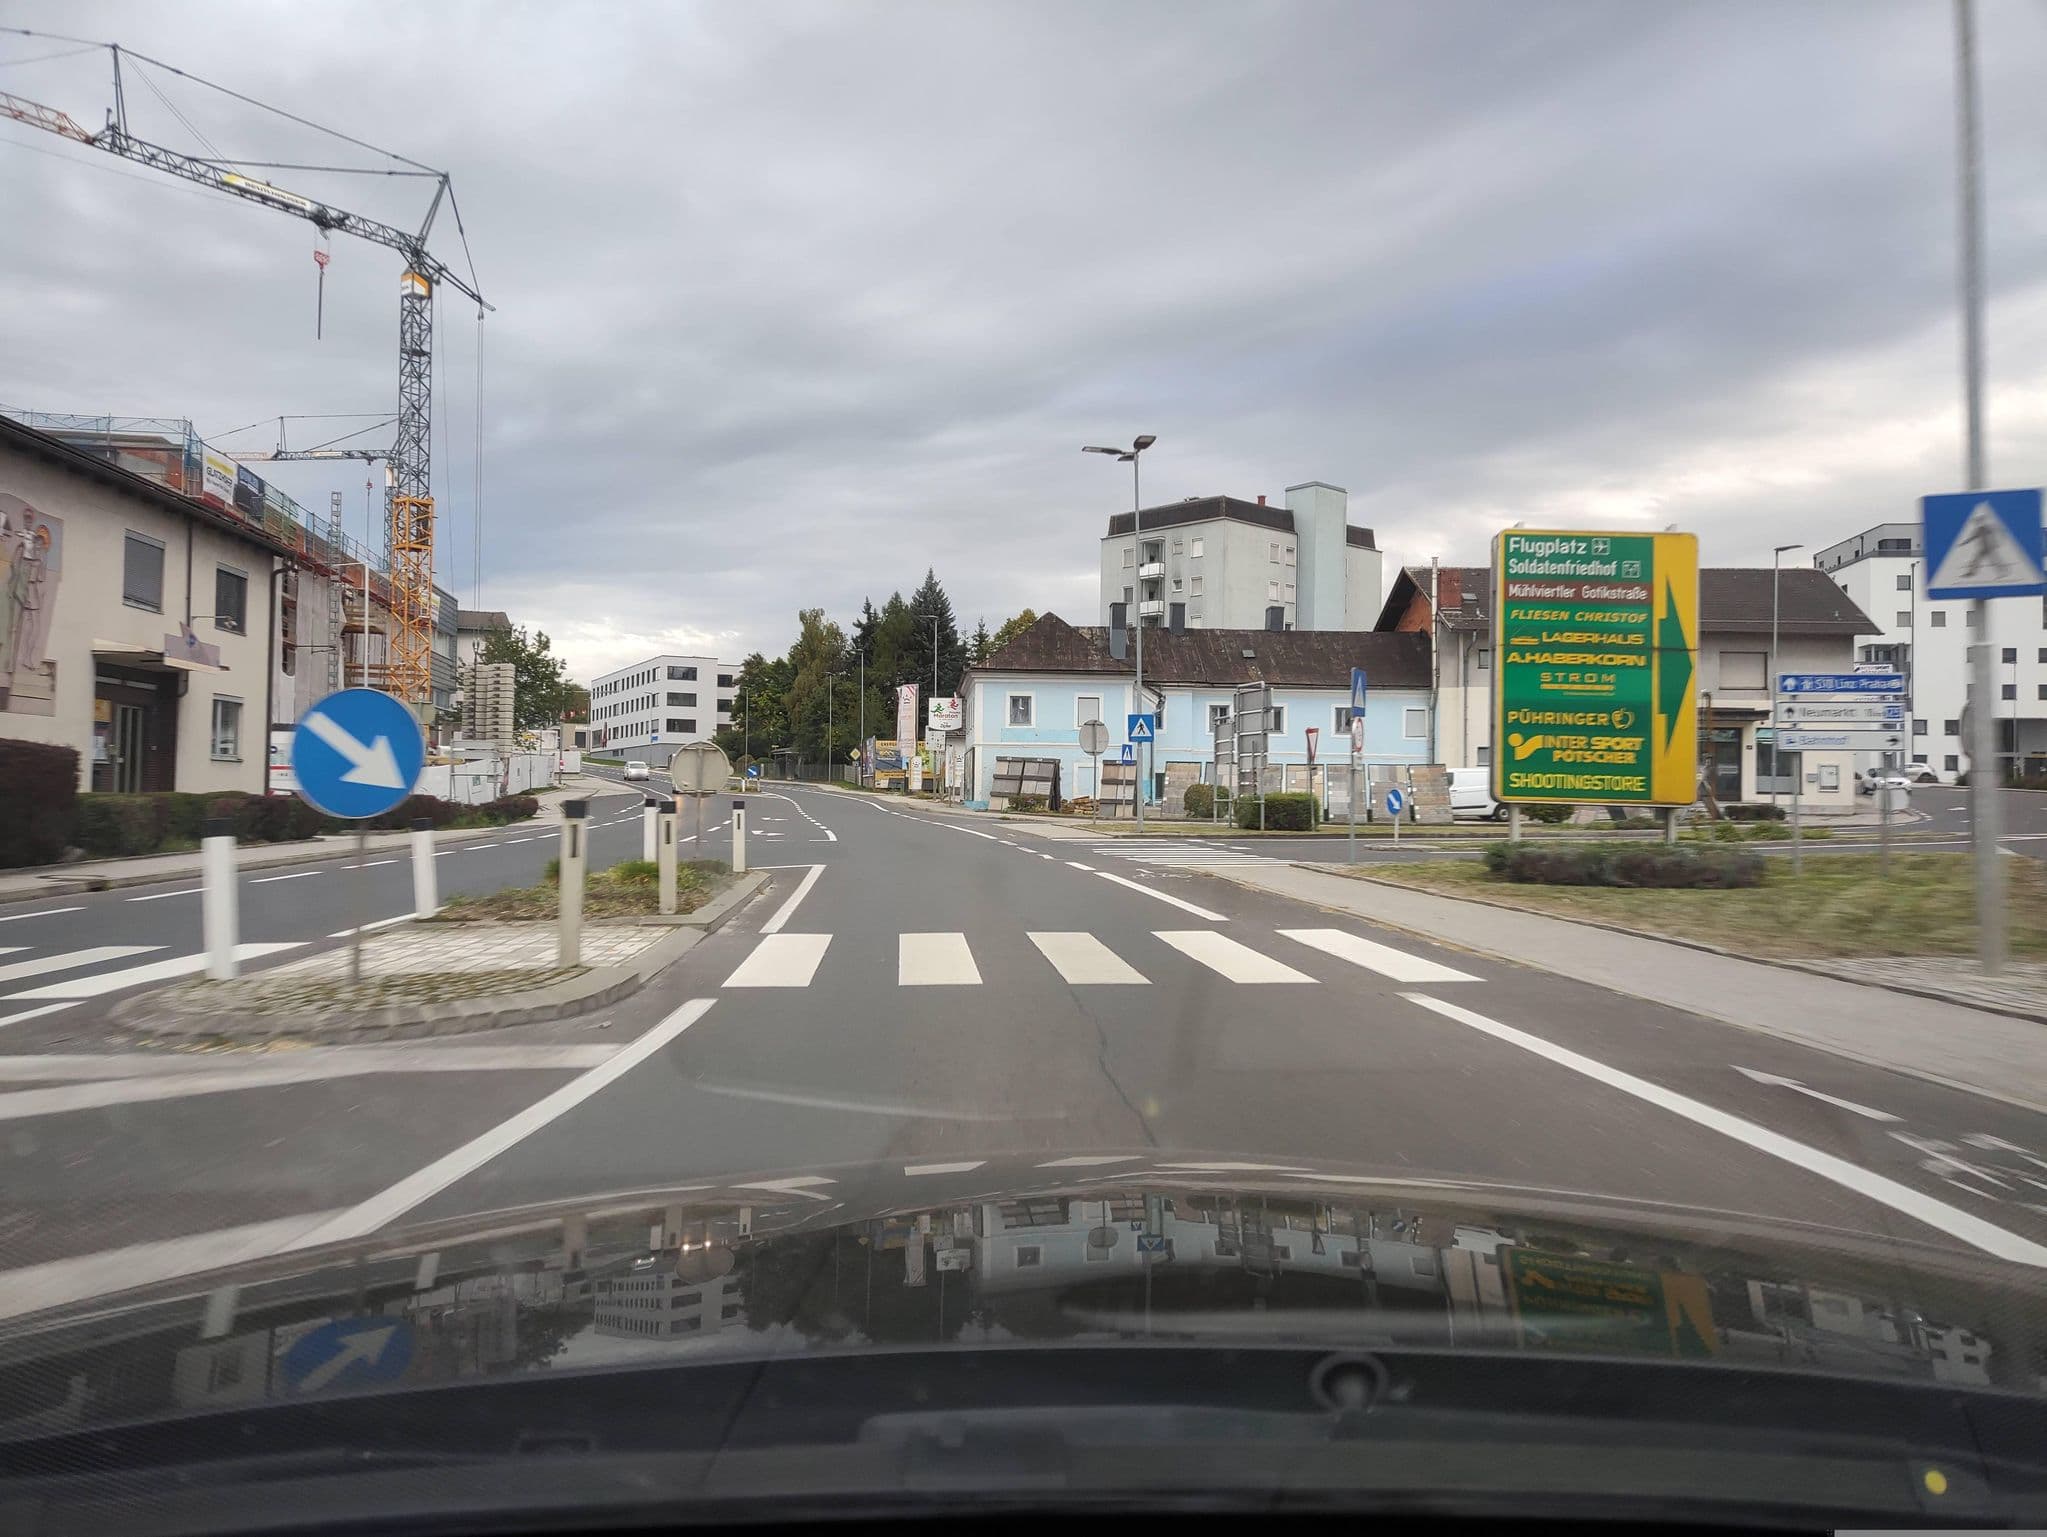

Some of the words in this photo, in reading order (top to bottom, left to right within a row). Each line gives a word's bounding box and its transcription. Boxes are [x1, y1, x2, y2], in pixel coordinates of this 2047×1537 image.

[1508, 537, 1587, 557] Flugplatz
[1508, 558, 1618, 577] Soldatenfriedhof
[1508, 583, 1576, 599] Mühlviertler
[1581, 584, 1648, 600] Gotikstraße
[1510, 609, 1569, 621] FLIESEN
[1575, 611, 1648, 623] CHRISTOF
[1542, 631, 1645, 645] LAGERHAUS
[1507, 652, 1647, 667] A.HABERKORN
[1540, 672, 1616, 684] STROM
[1507, 709, 1610, 726] PÜHRINGER
[1508, 773, 1647, 791] SHOOTINGSTORE
